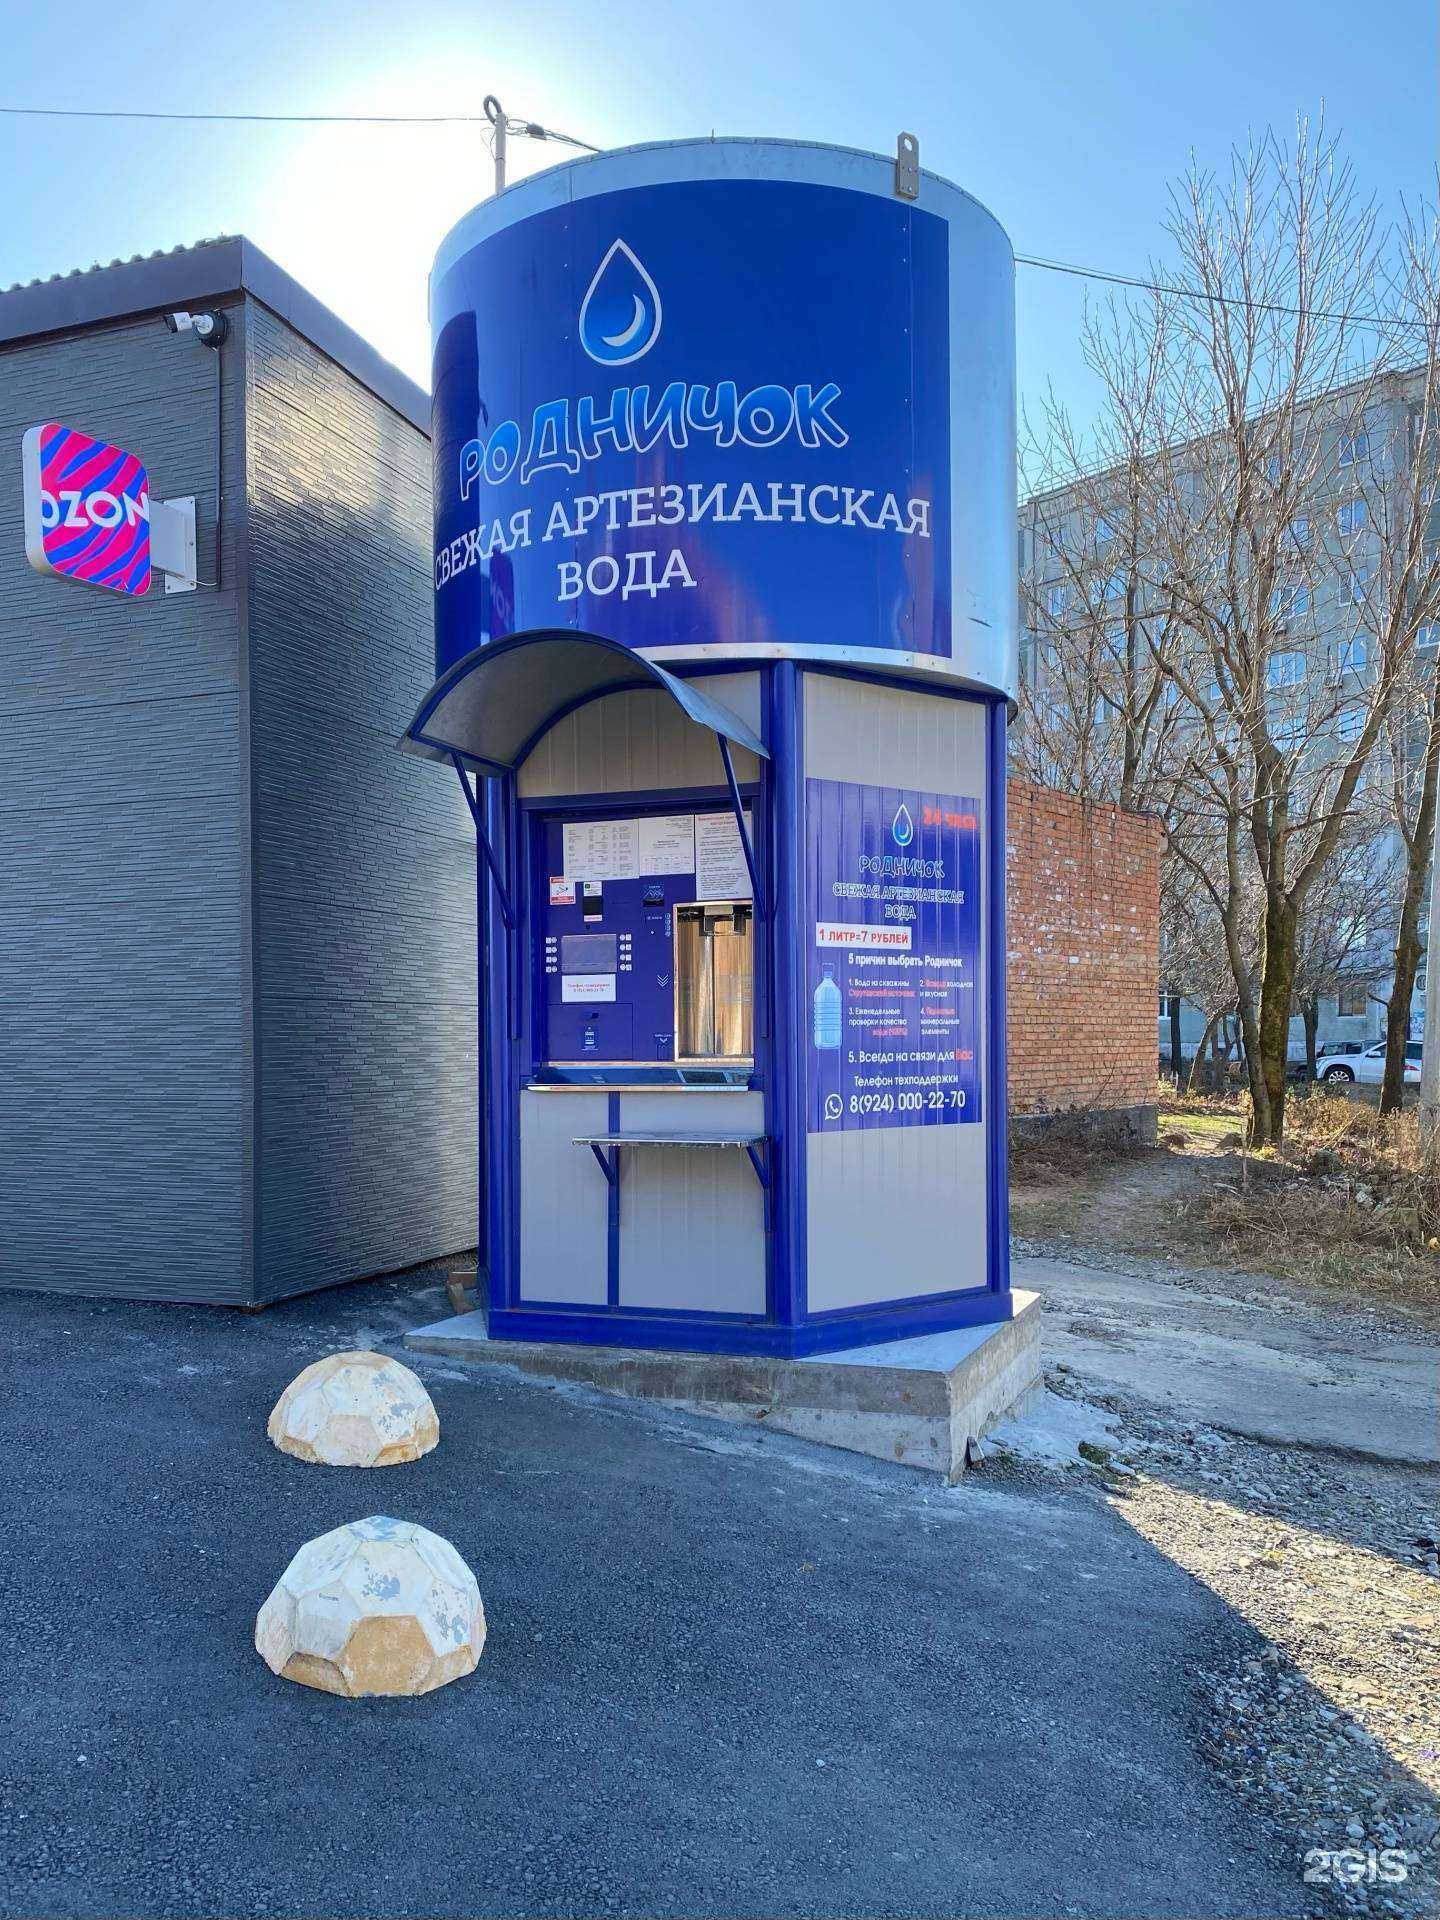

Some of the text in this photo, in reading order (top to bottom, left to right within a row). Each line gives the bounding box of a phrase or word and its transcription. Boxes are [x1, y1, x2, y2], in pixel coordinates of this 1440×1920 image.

[460, 380, 849, 501] РОДНИЧОК
[41, 490, 149, 528] OZON
[435, 481, 931, 591] СВЕЖАЯ АРТЕЗИАНСКАЯ
[557, 549, 698, 602] ВОДА
[859, 855, 945, 878] РОДНИЧОК
[832, 882, 965, 904] СВЕЖАЯ АРТЕЗИАНСКАЯ
[885, 904, 917, 921] ВОДА
[819, 928, 825, 941] 1
[871, 931, 909, 944] РУБЛЕЙ
[848, 953, 964, 969] 5 причин выбрать Родничок
[848, 1052, 857, 1063] 5.
[859, 1050, 894, 1063] Всегда
[895, 1053, 908, 1062] на
[910, 1052, 936, 1061] связи
[937, 1051, 955, 1062] для
[854, 1073, 959, 1087] Телефон техподдержки
[850, 1090, 966, 1115] 8(924) 000-22-70
